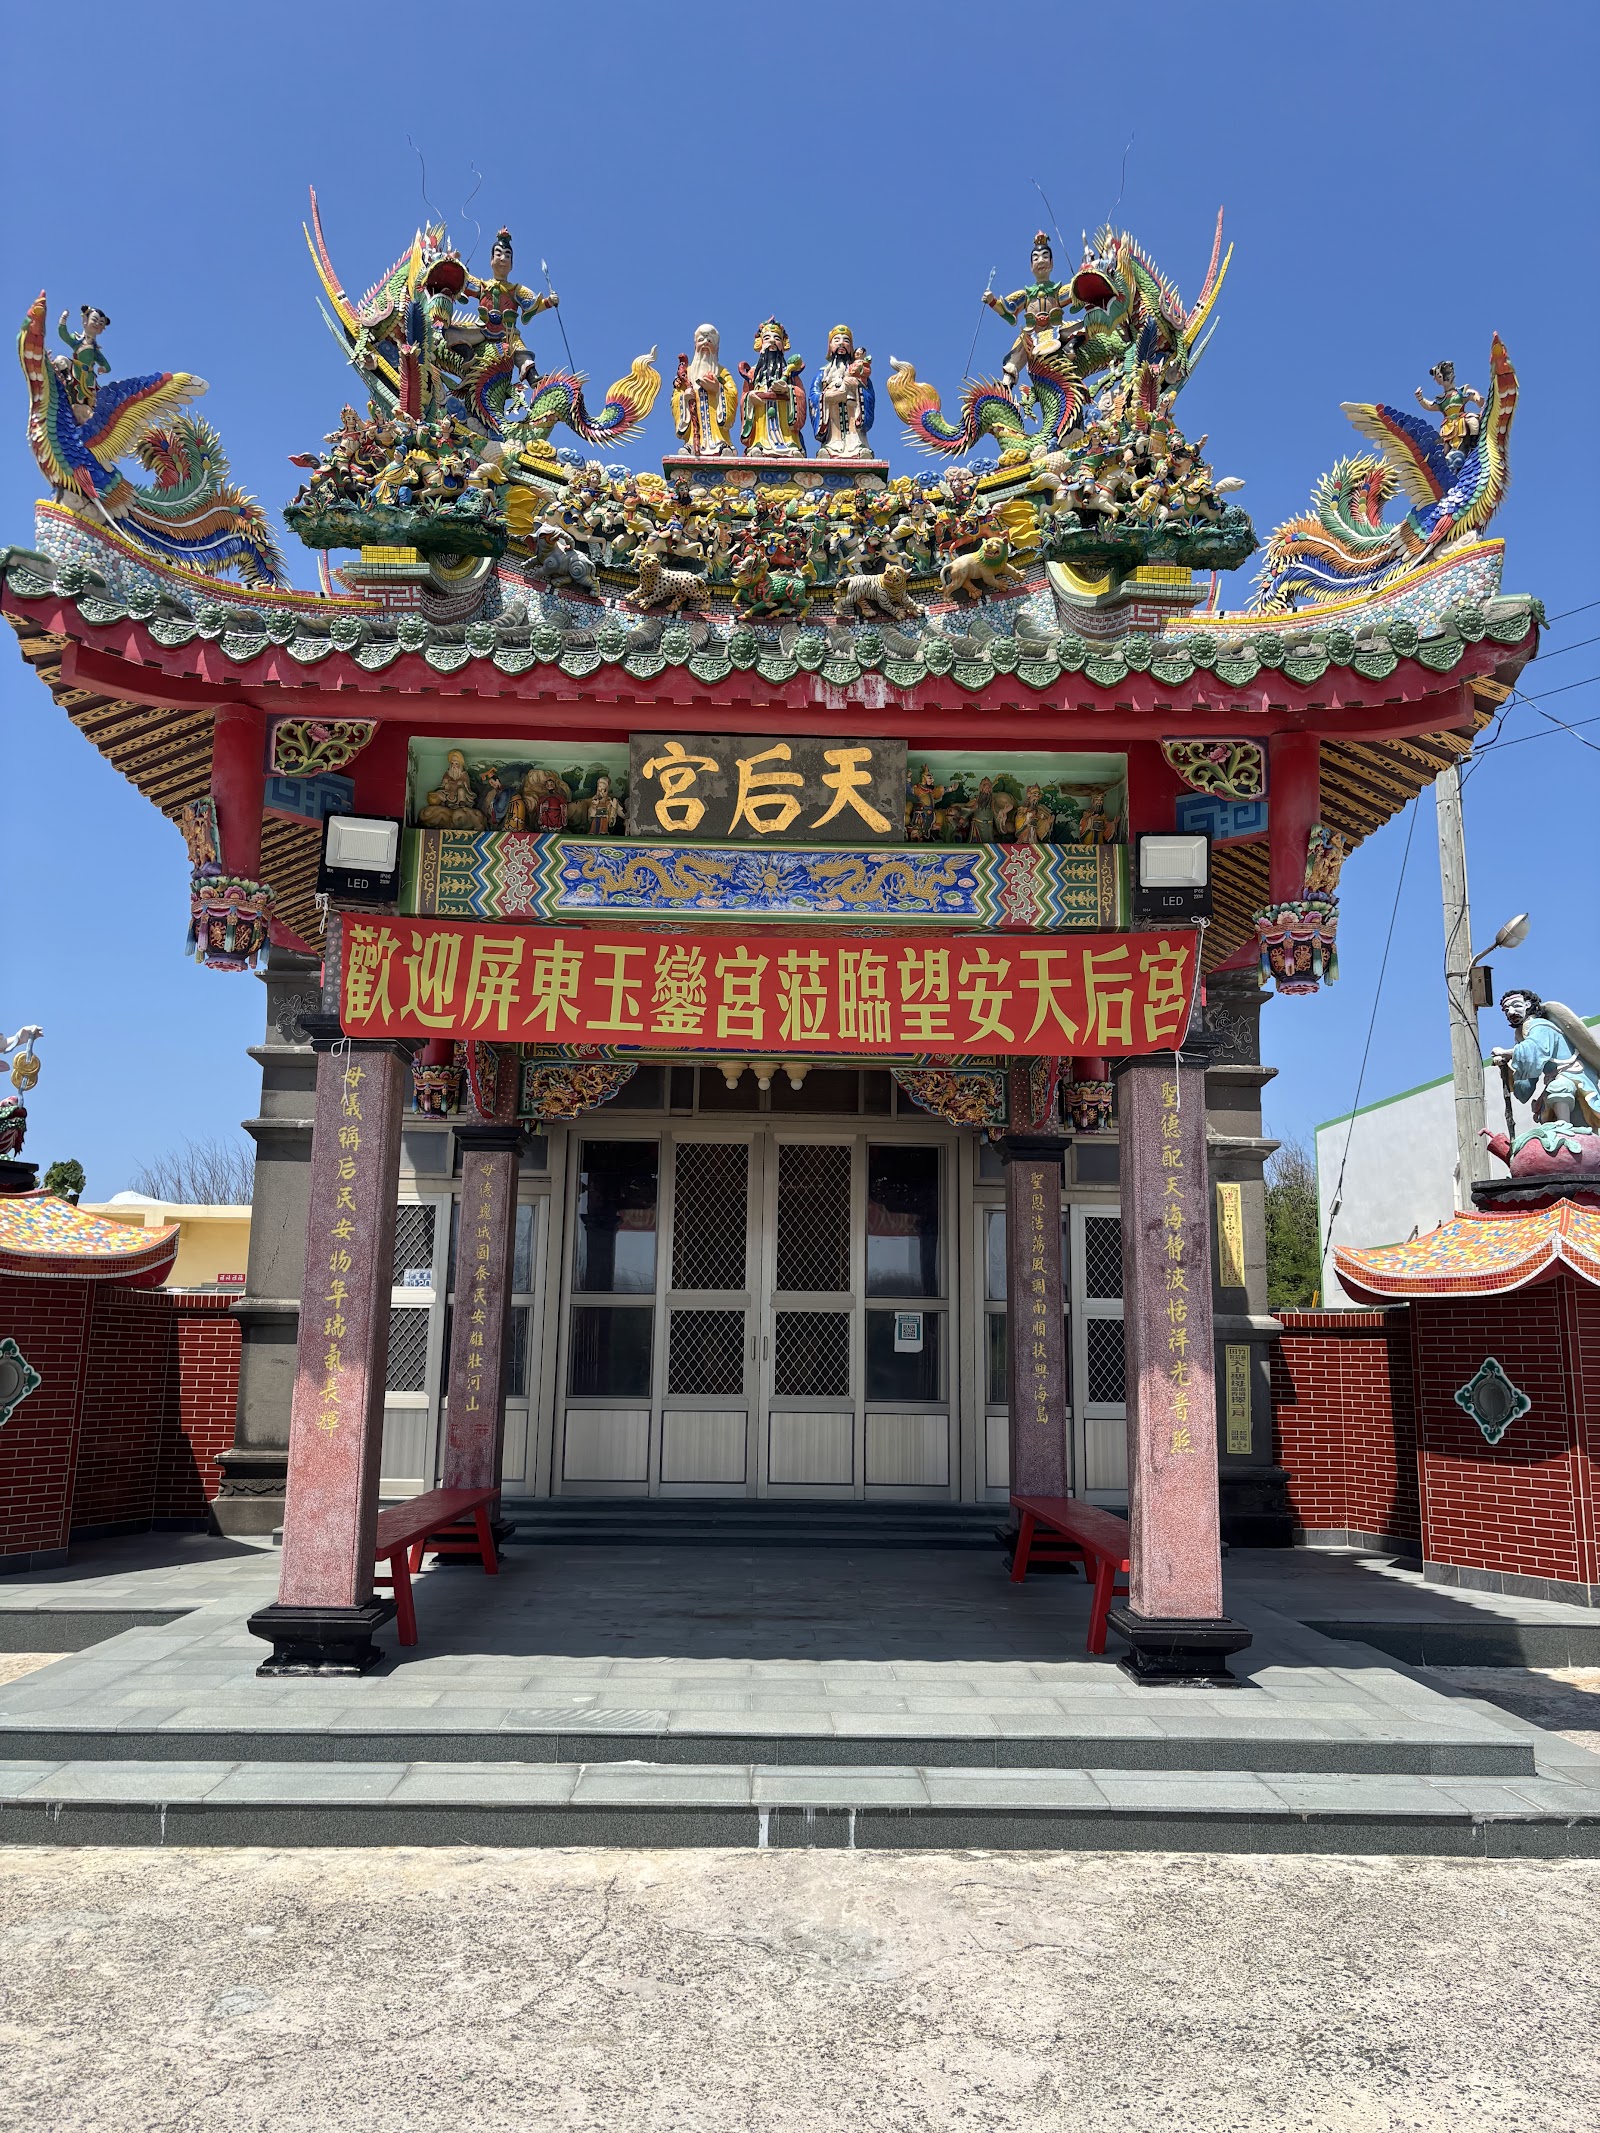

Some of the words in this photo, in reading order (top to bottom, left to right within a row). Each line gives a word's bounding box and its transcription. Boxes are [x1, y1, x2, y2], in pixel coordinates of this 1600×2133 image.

[642, 740, 891, 835] 天后宮
[347, 877, 369, 889] LED
[1162, 896, 1184, 906] LED
[345, 920, 1189, 1046] 歡迎屏東玉鑾宮蒞臨望安天后宮
